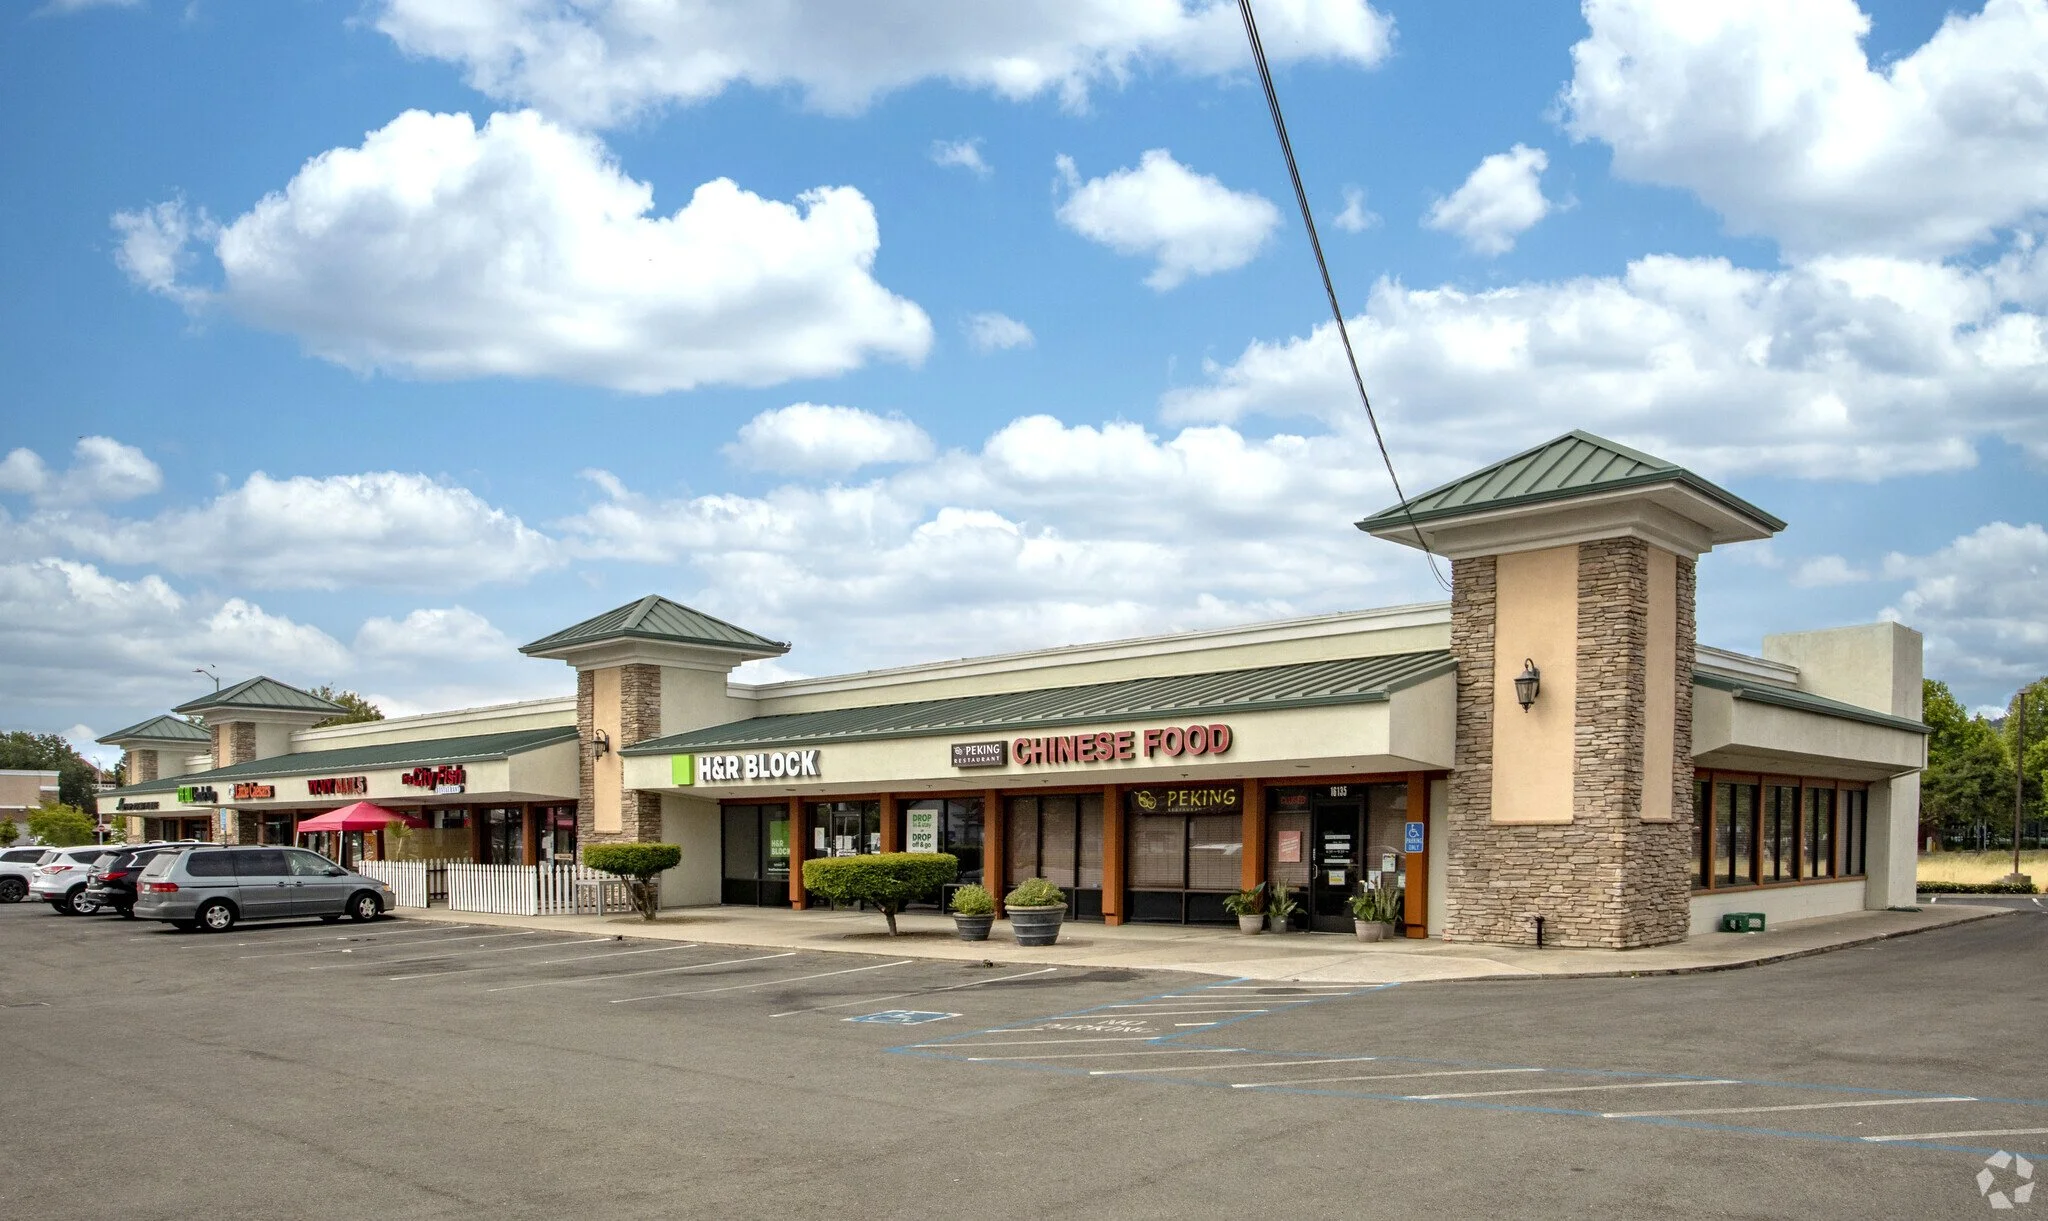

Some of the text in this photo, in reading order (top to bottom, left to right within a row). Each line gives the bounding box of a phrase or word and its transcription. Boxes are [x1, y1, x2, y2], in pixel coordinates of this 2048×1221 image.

[965, 743, 1001, 756] PEKING
[1011, 723, 1232, 766] CHINESE FOOD
[698, 749, 819, 781] H&R BLOCK
[953, 756, 1001, 764] RESTAURANT
[234, 783, 249, 799] Little
[249, 782, 273, 798] Caesars
[334, 776, 366, 794] NAILS
[1330, 786, 1347, 797] 16135
[1167, 788, 1236, 806] PEKING
[771, 839, 784, 847] H&R
[912, 833, 932, 841] DROP
